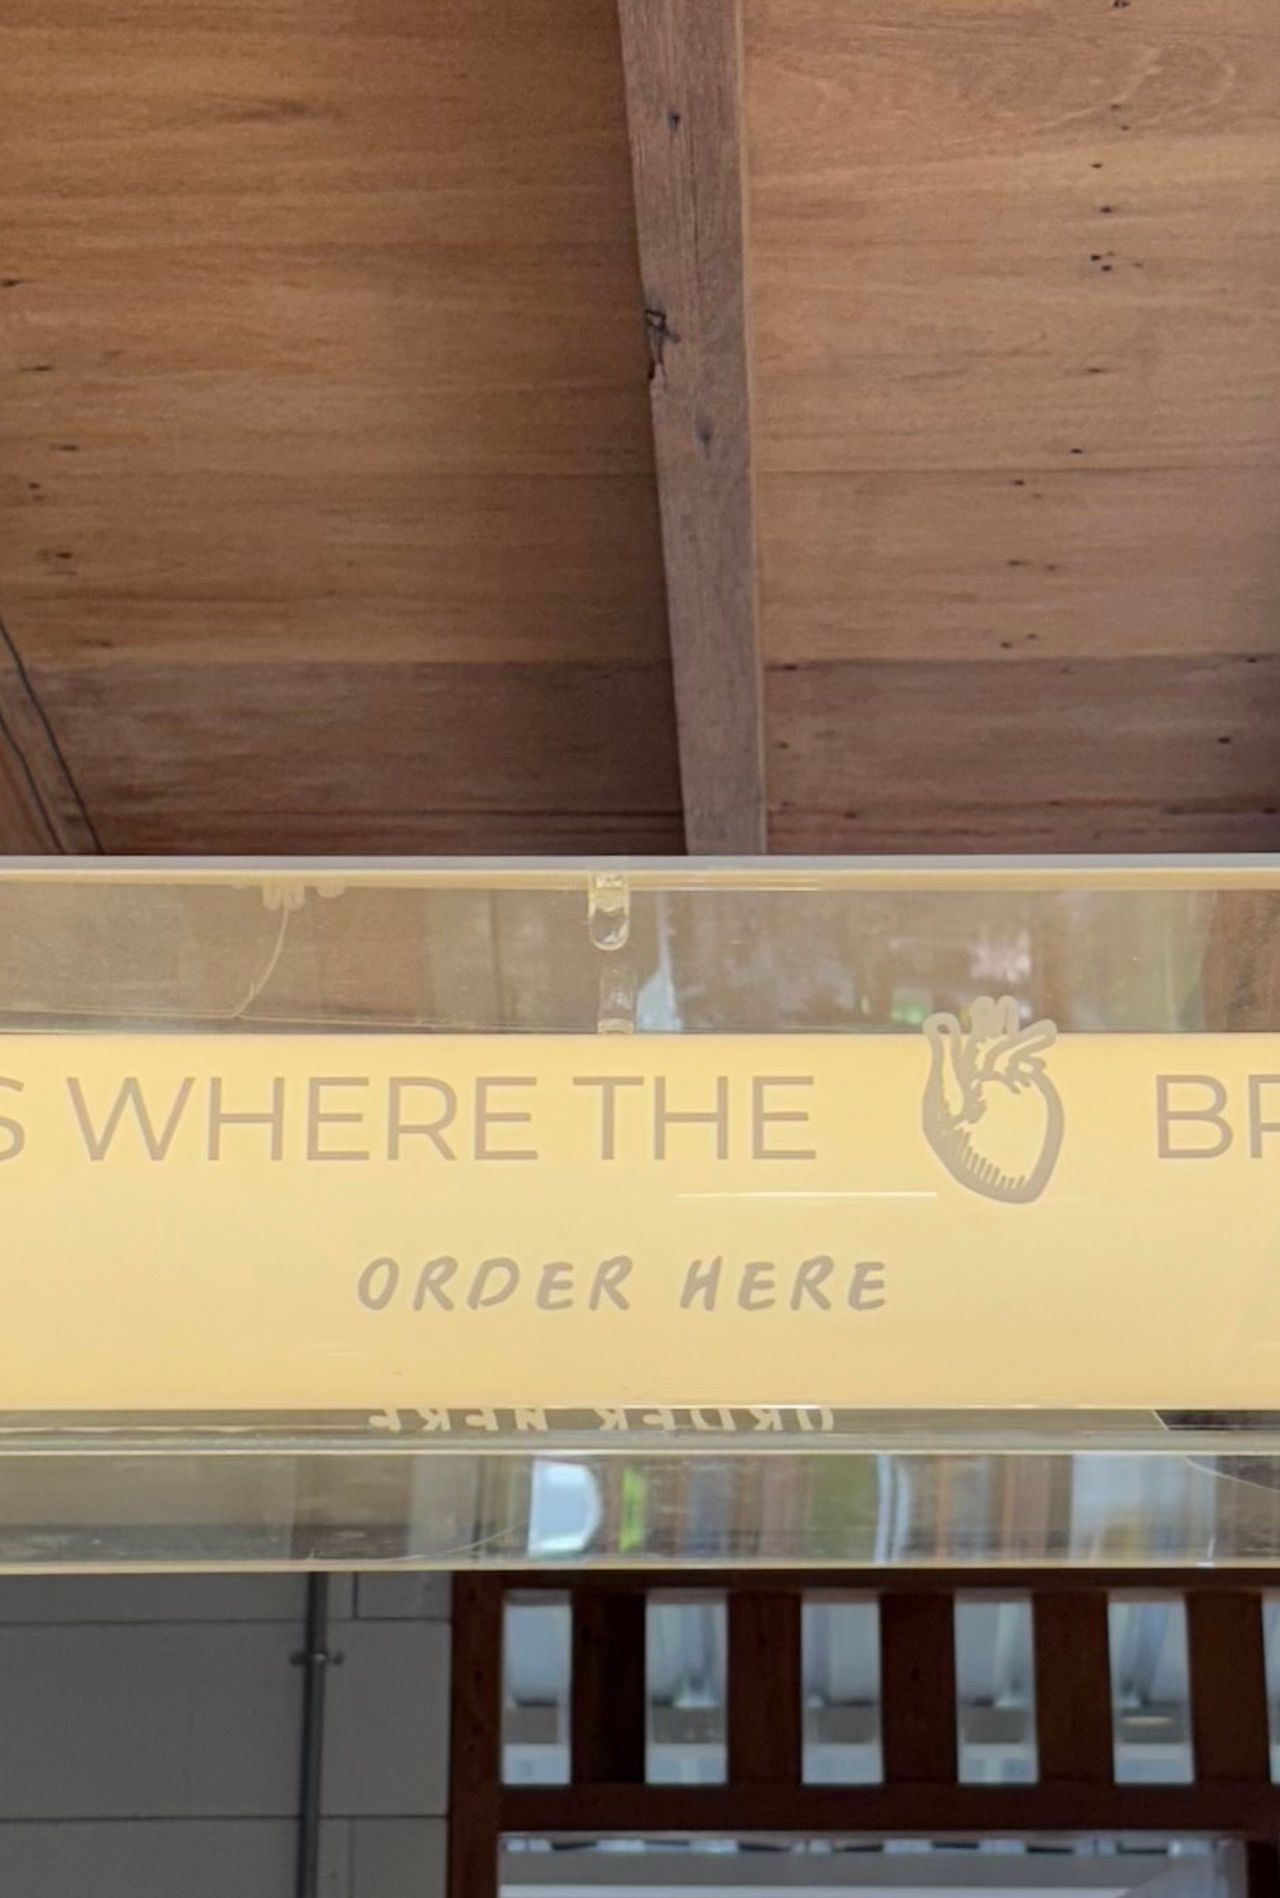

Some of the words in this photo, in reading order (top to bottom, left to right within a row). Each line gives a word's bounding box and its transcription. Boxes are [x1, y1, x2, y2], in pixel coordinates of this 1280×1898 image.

[66, 1076, 539, 1162] WHERE
[572, 1075, 817, 1161] THE
[358, 1255, 634, 1312] ORDER
[680, 1255, 888, 1312] HERE
